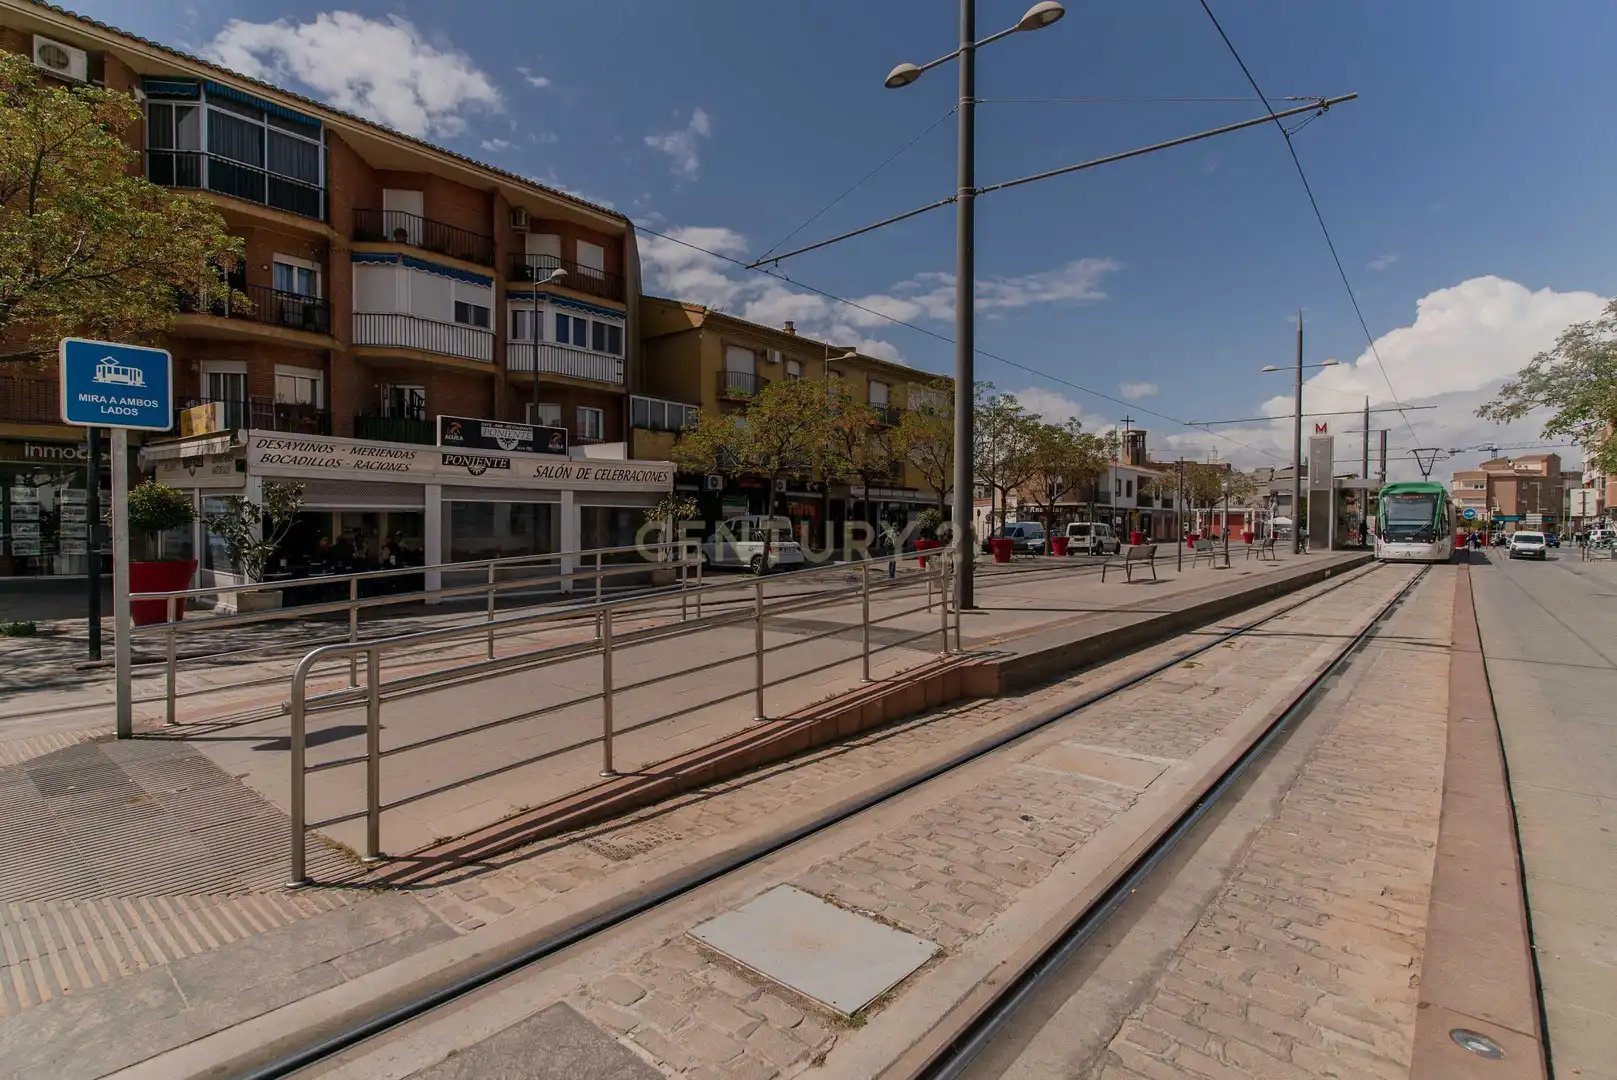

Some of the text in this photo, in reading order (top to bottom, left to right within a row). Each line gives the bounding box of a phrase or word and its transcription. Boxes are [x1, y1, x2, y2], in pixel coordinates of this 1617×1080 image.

[78, 393, 159, 408] MIRA A AMBOS
[100, 405, 139, 416] LADOS
[482, 428, 533, 440] PONIENTE
[1315, 422, 1328, 434] M
[255, 439, 336, 453] DESAYUNOS
[349, 446, 418, 460] MERIENDAS
[260, 453, 343, 468] BOCADILLOS
[353, 459, 412, 472] RACIONES
[444, 455, 508, 468] PONIENTE
[533, 464, 669, 483] SALÓN DE CELEBRACIONES
